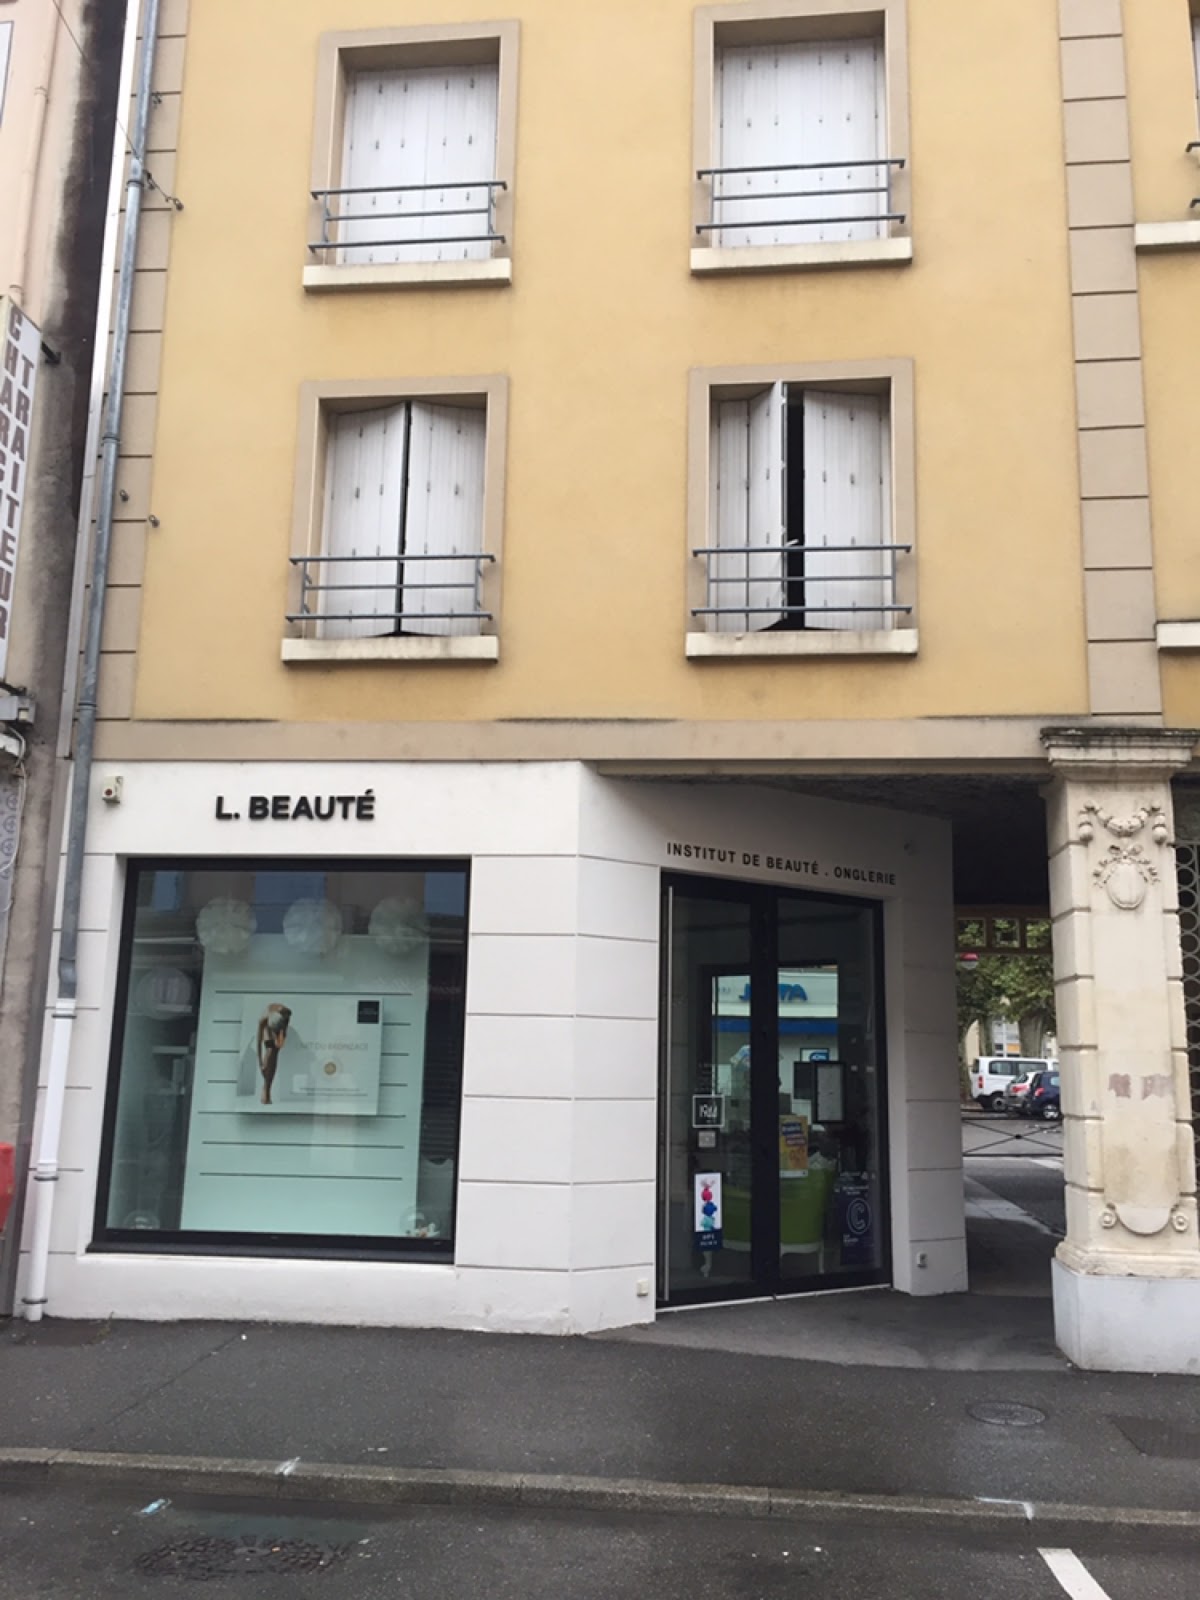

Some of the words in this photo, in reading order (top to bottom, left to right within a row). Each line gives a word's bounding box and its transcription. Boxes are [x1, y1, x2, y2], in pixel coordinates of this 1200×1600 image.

[215, 795, 240, 820] L.
[248, 788, 375, 820] BEAUTÉ
[666, 842, 736, 863] INSTITUT
[742, 852, 760, 866] DE
[766, 856, 819, 876] BEAUTÉ
[834, 866, 897, 885] ONGLERIE
